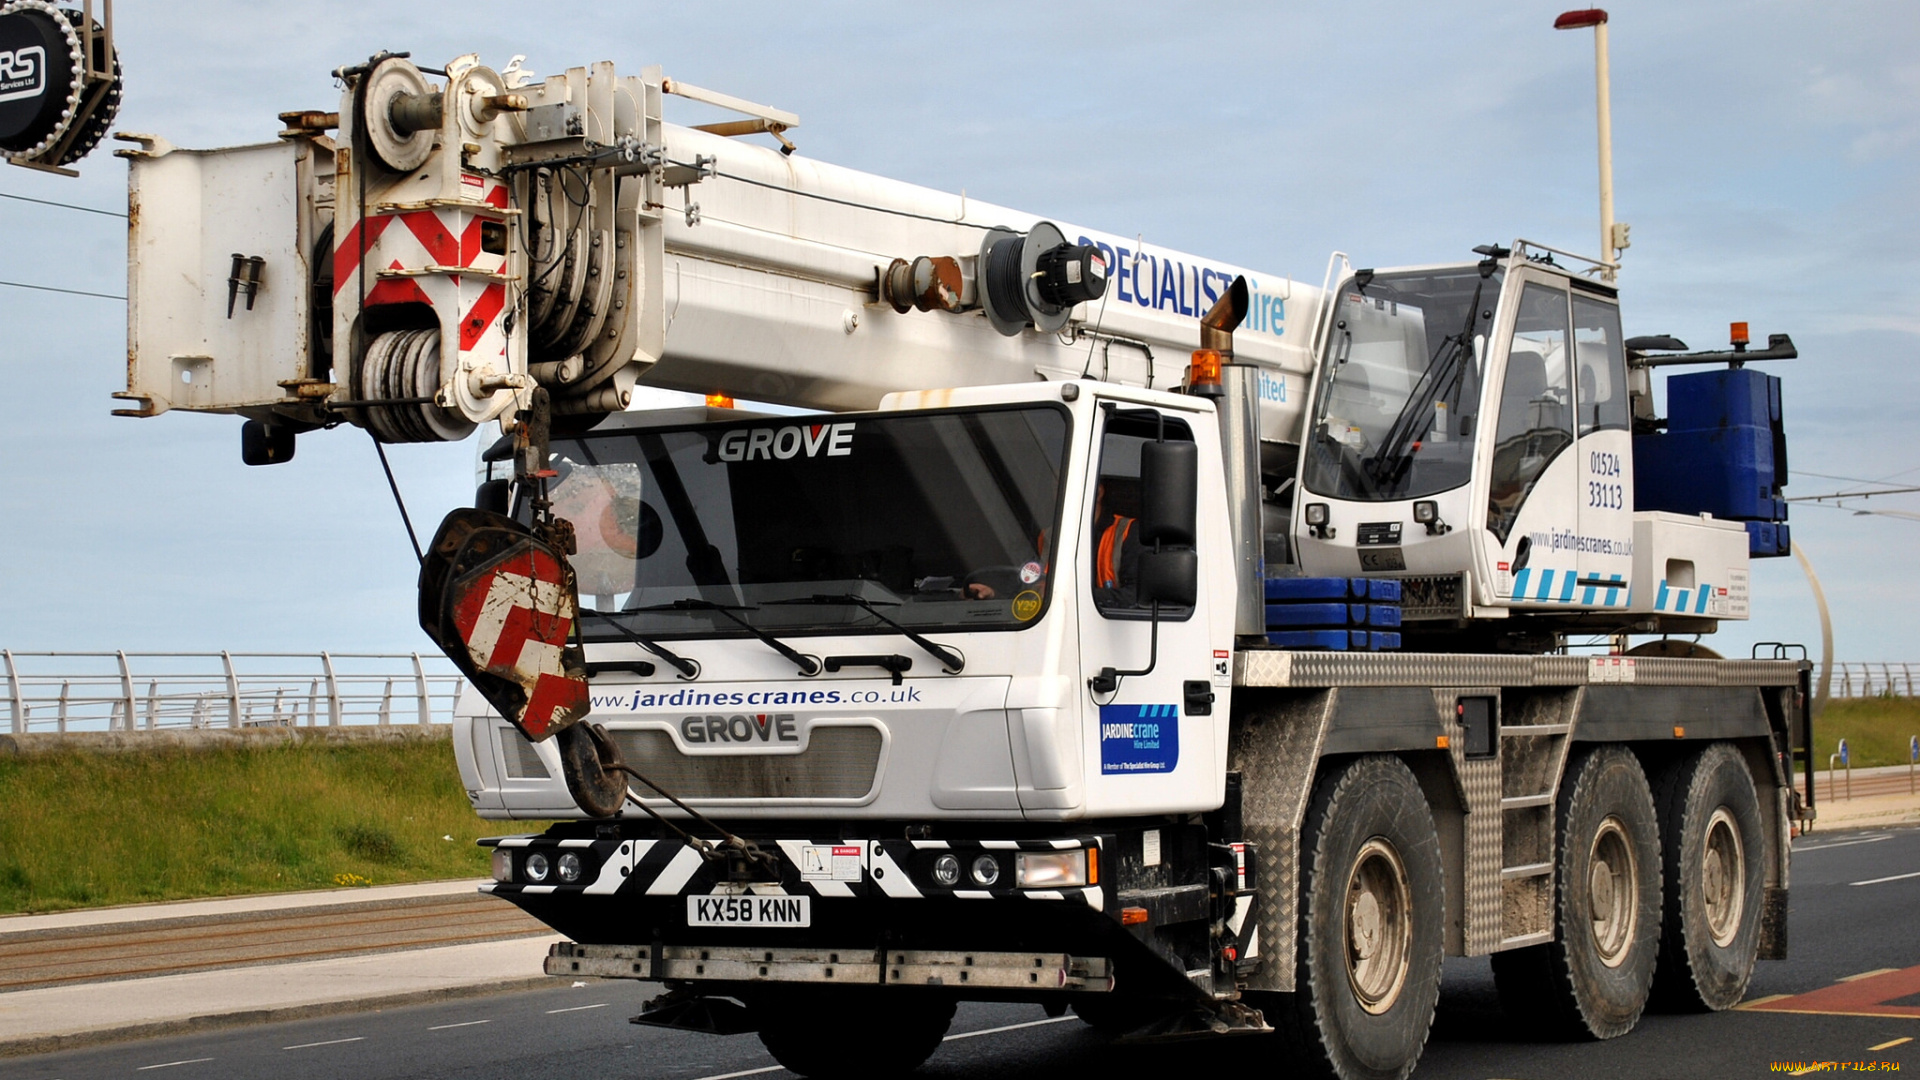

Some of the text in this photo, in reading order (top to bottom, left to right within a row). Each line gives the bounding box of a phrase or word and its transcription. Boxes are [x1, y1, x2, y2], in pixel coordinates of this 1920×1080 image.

[1, 78, 35, 90] Services Ltd
[718, 422, 856, 461] GROVE
[1590, 451, 1620, 478] 01524
[1589, 481, 1623, 510] 33113
[1017, 600, 1038, 611] Y29
[681, 713, 798, 743] GROVE
[1134, 740, 1160, 749] Hire Limited
[698, 898, 801, 922] KX58 KNN
